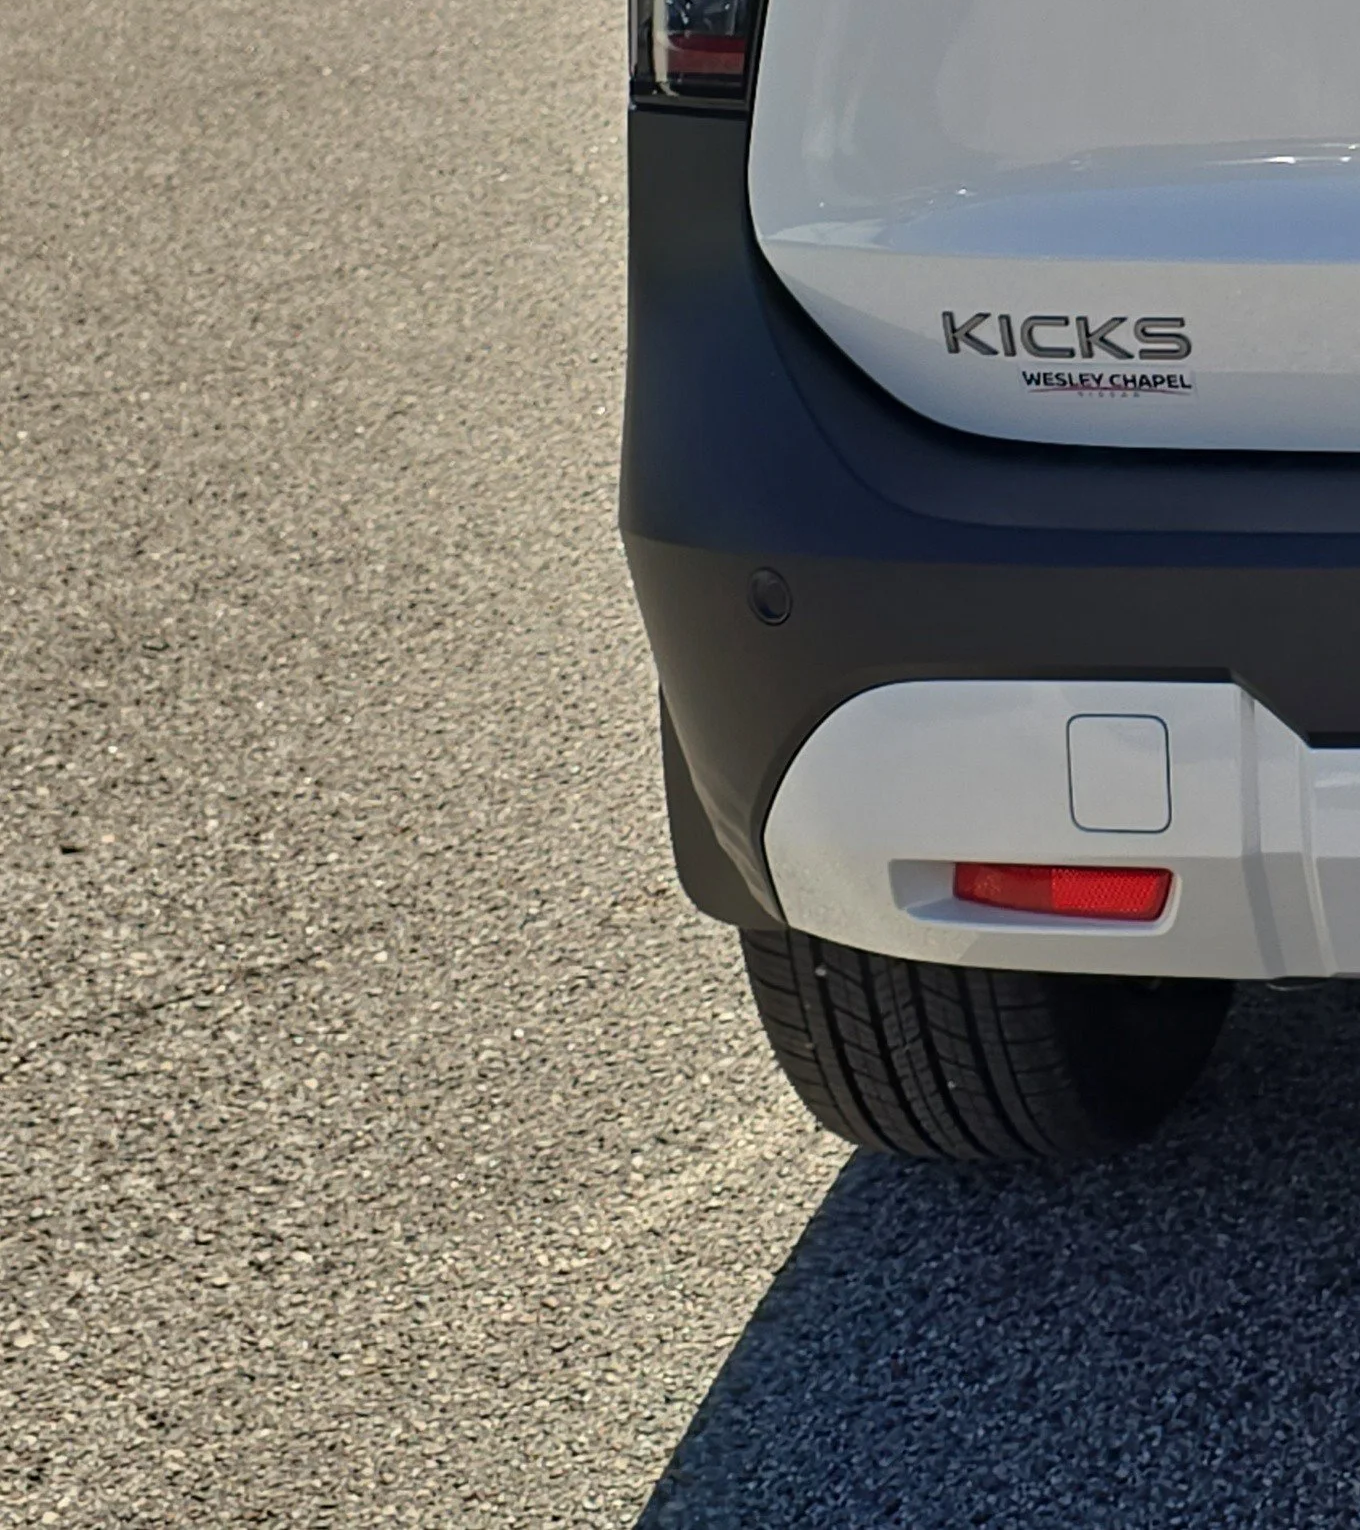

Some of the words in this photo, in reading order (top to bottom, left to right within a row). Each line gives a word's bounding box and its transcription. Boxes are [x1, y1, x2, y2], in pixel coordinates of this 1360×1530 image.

[942, 311, 1192, 360] KICKS
[1021, 371, 1104, 388] WESLEY
[1108, 373, 1192, 389] CHAPEL
